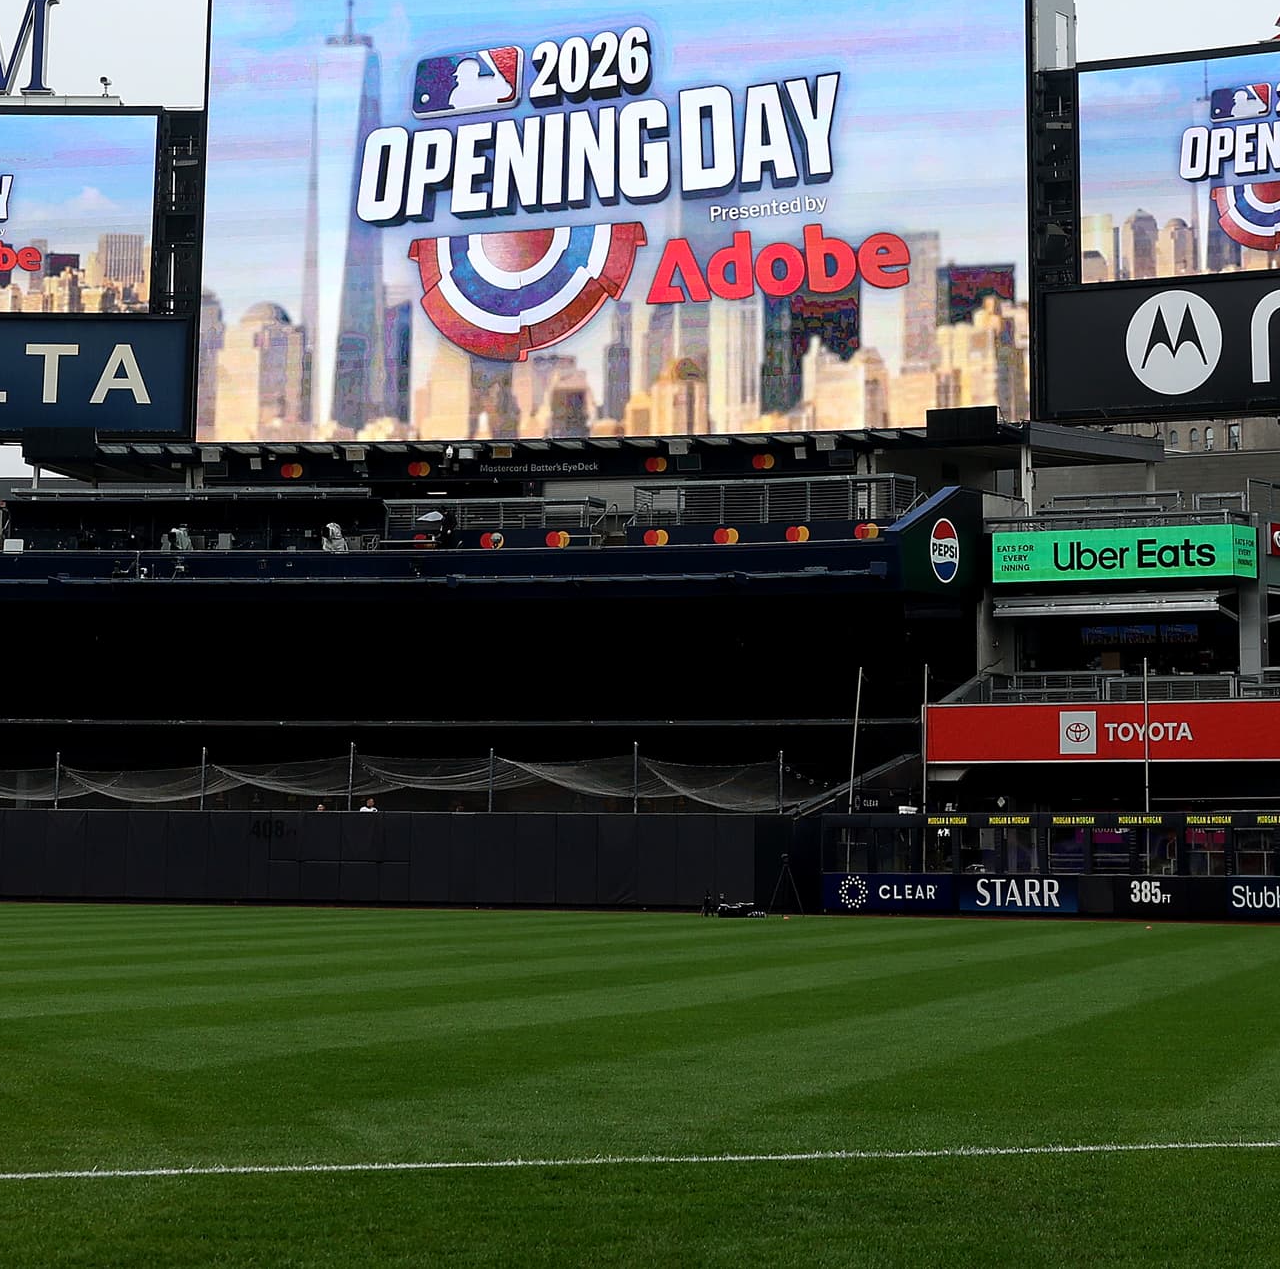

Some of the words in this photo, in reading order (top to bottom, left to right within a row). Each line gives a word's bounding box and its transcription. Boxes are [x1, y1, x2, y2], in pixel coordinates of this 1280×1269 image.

[529, 26, 652, 102] 2026
[356, 99, 671, 228] OPENING
[678, 72, 841, 198] DAY
[710, 198, 802, 222] Presented
[804, 196, 828, 214] by
[646, 224, 911, 304] Adobe
[480, 464, 528, 472] Mastercard
[578, 462, 598, 471] Deck
[931, 542, 958, 559] PEPSI
[997, 545, 1016, 553] EATS
[1003, 554, 1028, 562] EVERY
[1054, 541, 1129, 571] Uber
[1137, 538, 1215, 568] Eats
[1001, 564, 1030, 572] INNING
[1104, 722, 1193, 742] TOYOTA
[878, 884, 937, 900] CLEAR
[976, 878, 1060, 908] STARR
[1130, 881, 1161, 904] 385
[1162, 894, 1171, 904] FT
